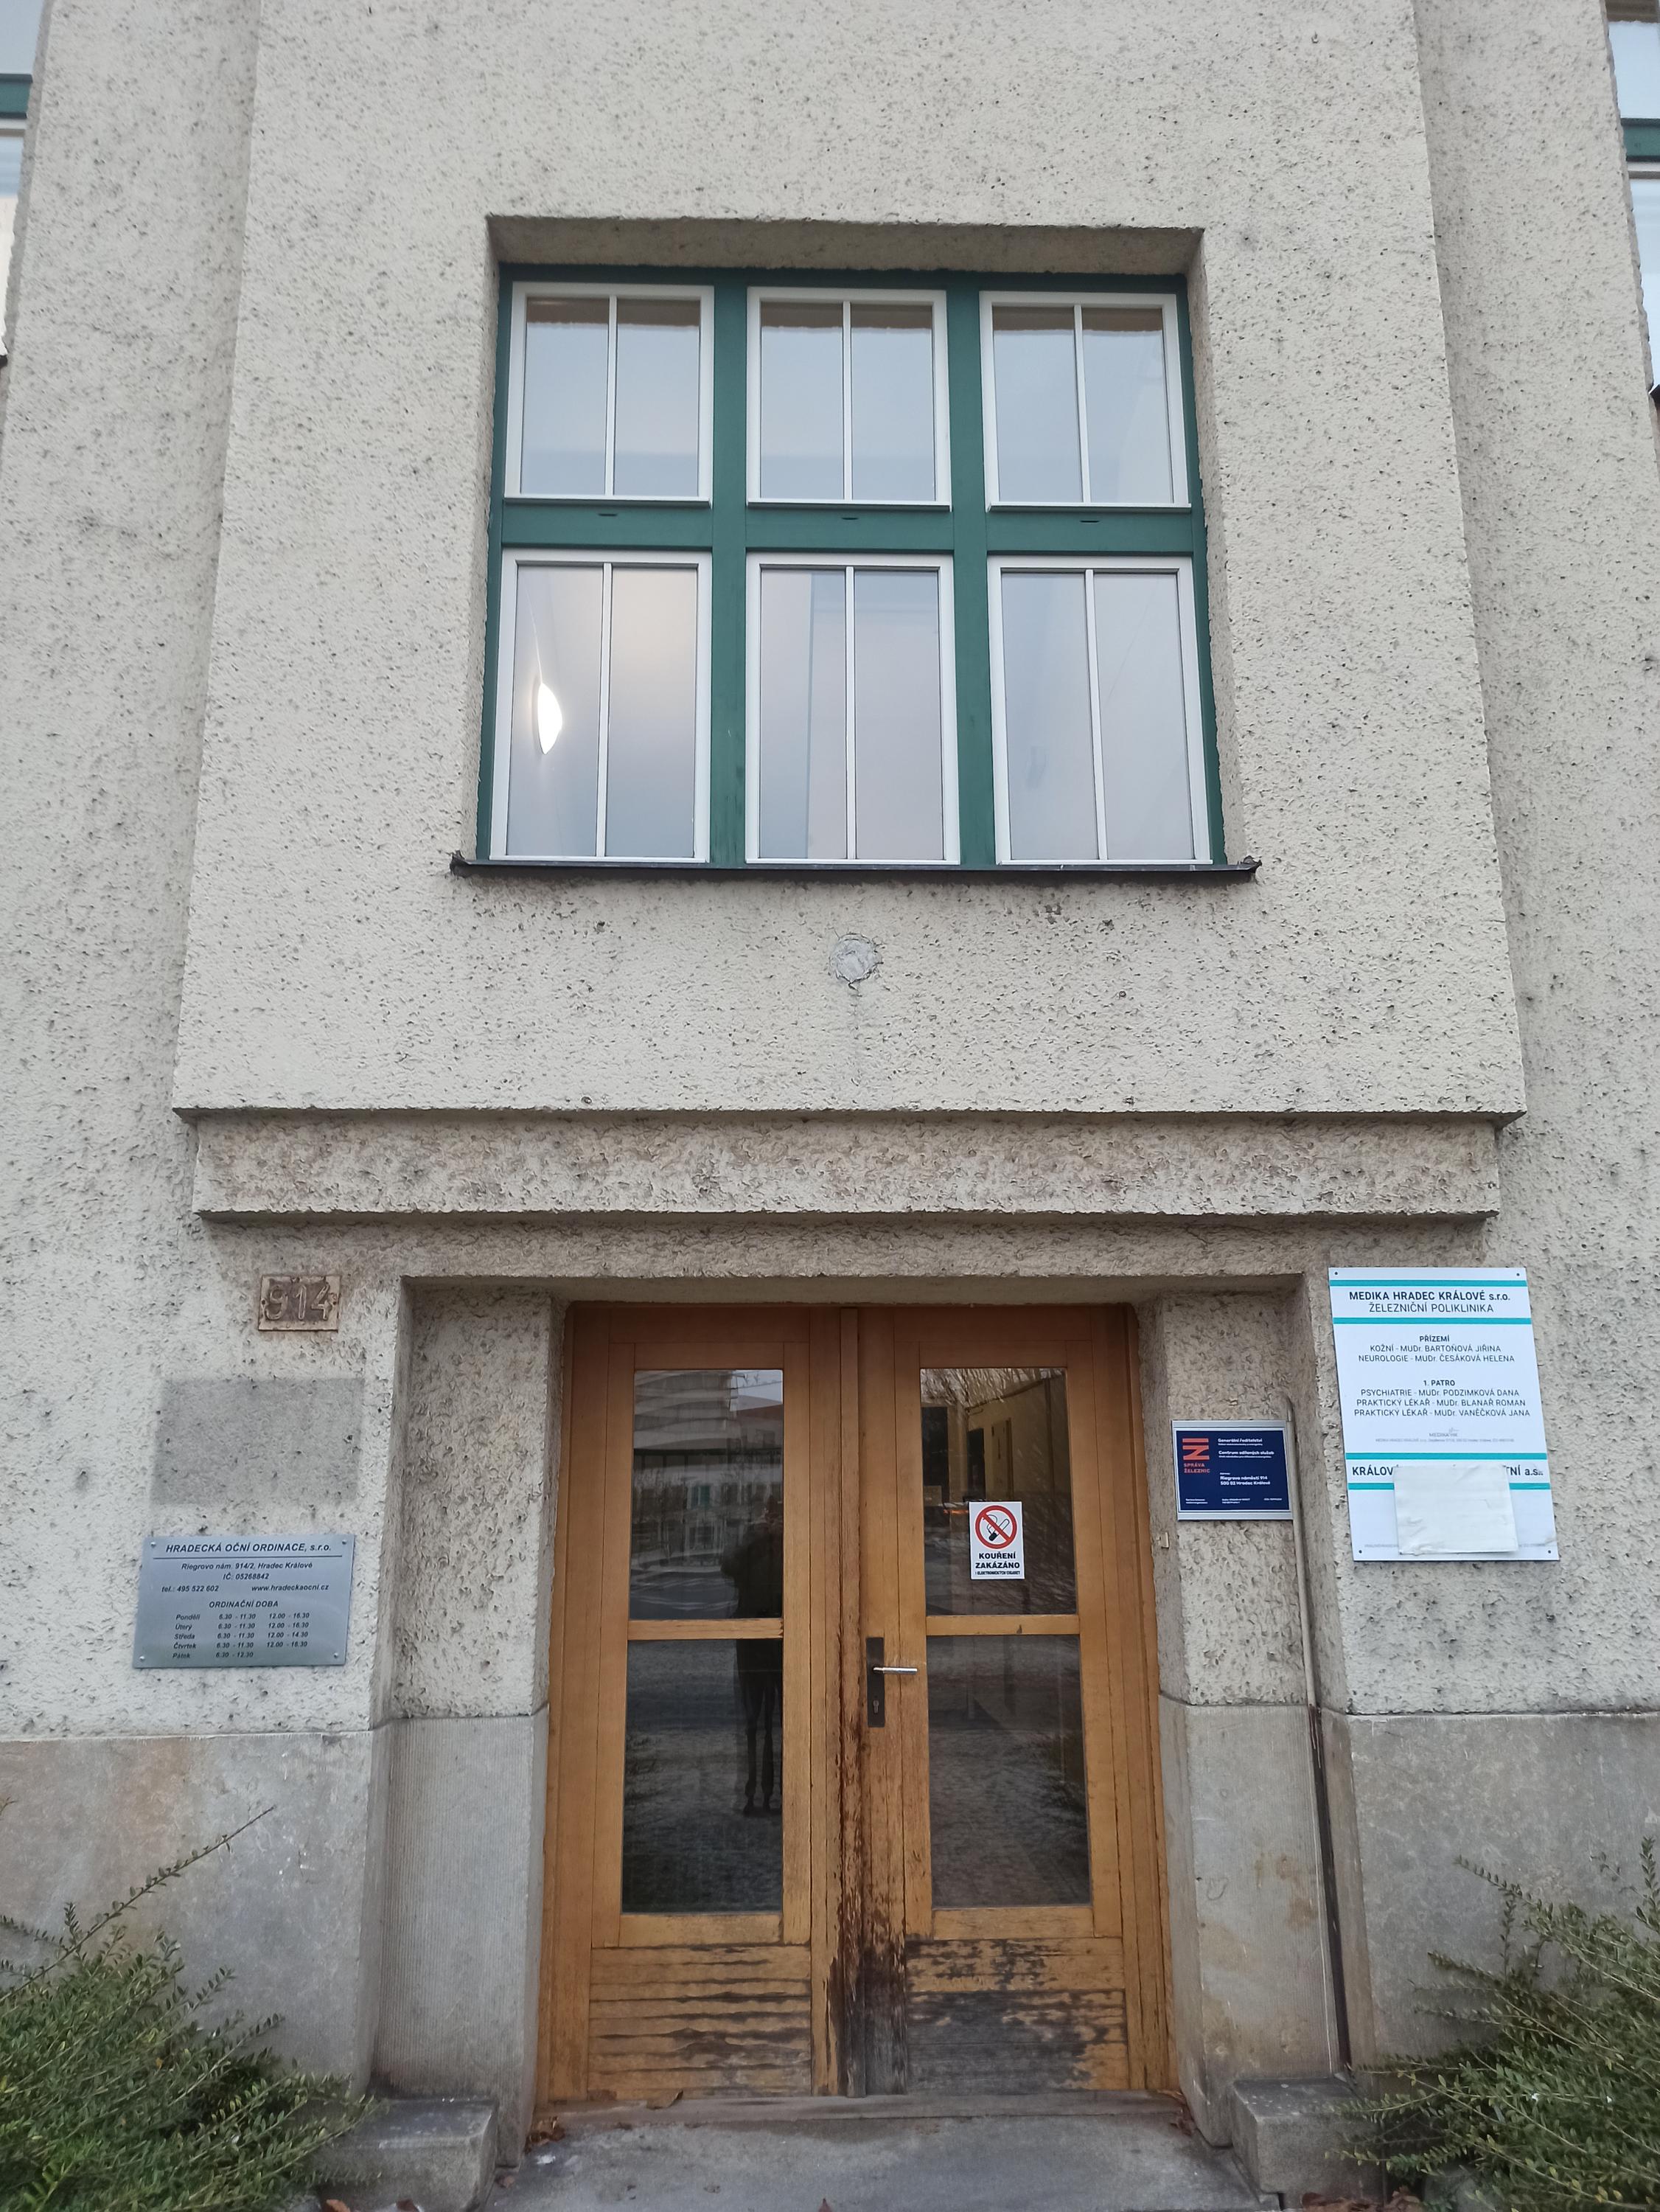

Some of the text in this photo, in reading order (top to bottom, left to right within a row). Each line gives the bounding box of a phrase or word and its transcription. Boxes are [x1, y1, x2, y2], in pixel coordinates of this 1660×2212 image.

[1349, 1291, 1389, 1300] MEDIKA
[1393, 1291, 1435, 1300] HRADEC
[1438, 1290, 1486, 1300] KRÁLOVÉ
[265, 1284, 329, 1320] 914
[1369, 1301, 1494, 1312] ŽELEZNIČNÍ POLIKLINIKA
[1419, 1334, 1450, 1342] PŘÍZEMÍ
[1370, 1343, 1394, 1352] KOŽNÍ
[1424, 1343, 1474, 1352] BARTOŇOVÁ
[1475, 1343, 1502, 1352] JIŘINA
[1439, 1354, 1482, 1362] ČESÁKOVÁ
[1361, 1388, 1412, 1397] PSYCHIATRIE
[1443, 1388, 1495, 1397] PODZIMKOVÁ
[1496, 1388, 1520, 1397] DANA
[1356, 1398, 1402, 1406] PRAKTICKÝ
[1404, 1398, 1431, 1406] LÉKAŘ
[1461, 1398, 1494, 1406] BLANAŘ
[1354, 1408, 1400, 1416] PRAKTICKÝ
[1401, 1408, 1429, 1416] LÉKAŘ
[1458, 1408, 1507, 1416] VANĚČKOVÁ
[1352, 1464, 1394, 1475] KRÁLOV
[165, 1543, 222, 1553] HRADECKÁ
[225, 1542, 251, 1552] OČNÍ
[252, 1543, 307, 1552] ORDINACE,
[978, 1551, 1016, 1559] KOUŘENÍ
[181, 1562, 214, 1571] Riegrovo
[975, 1560, 1020, 1569] ZAKÁZÁNO
[209, 1599, 279, 1608] ORDINAČNÍ DOBA
